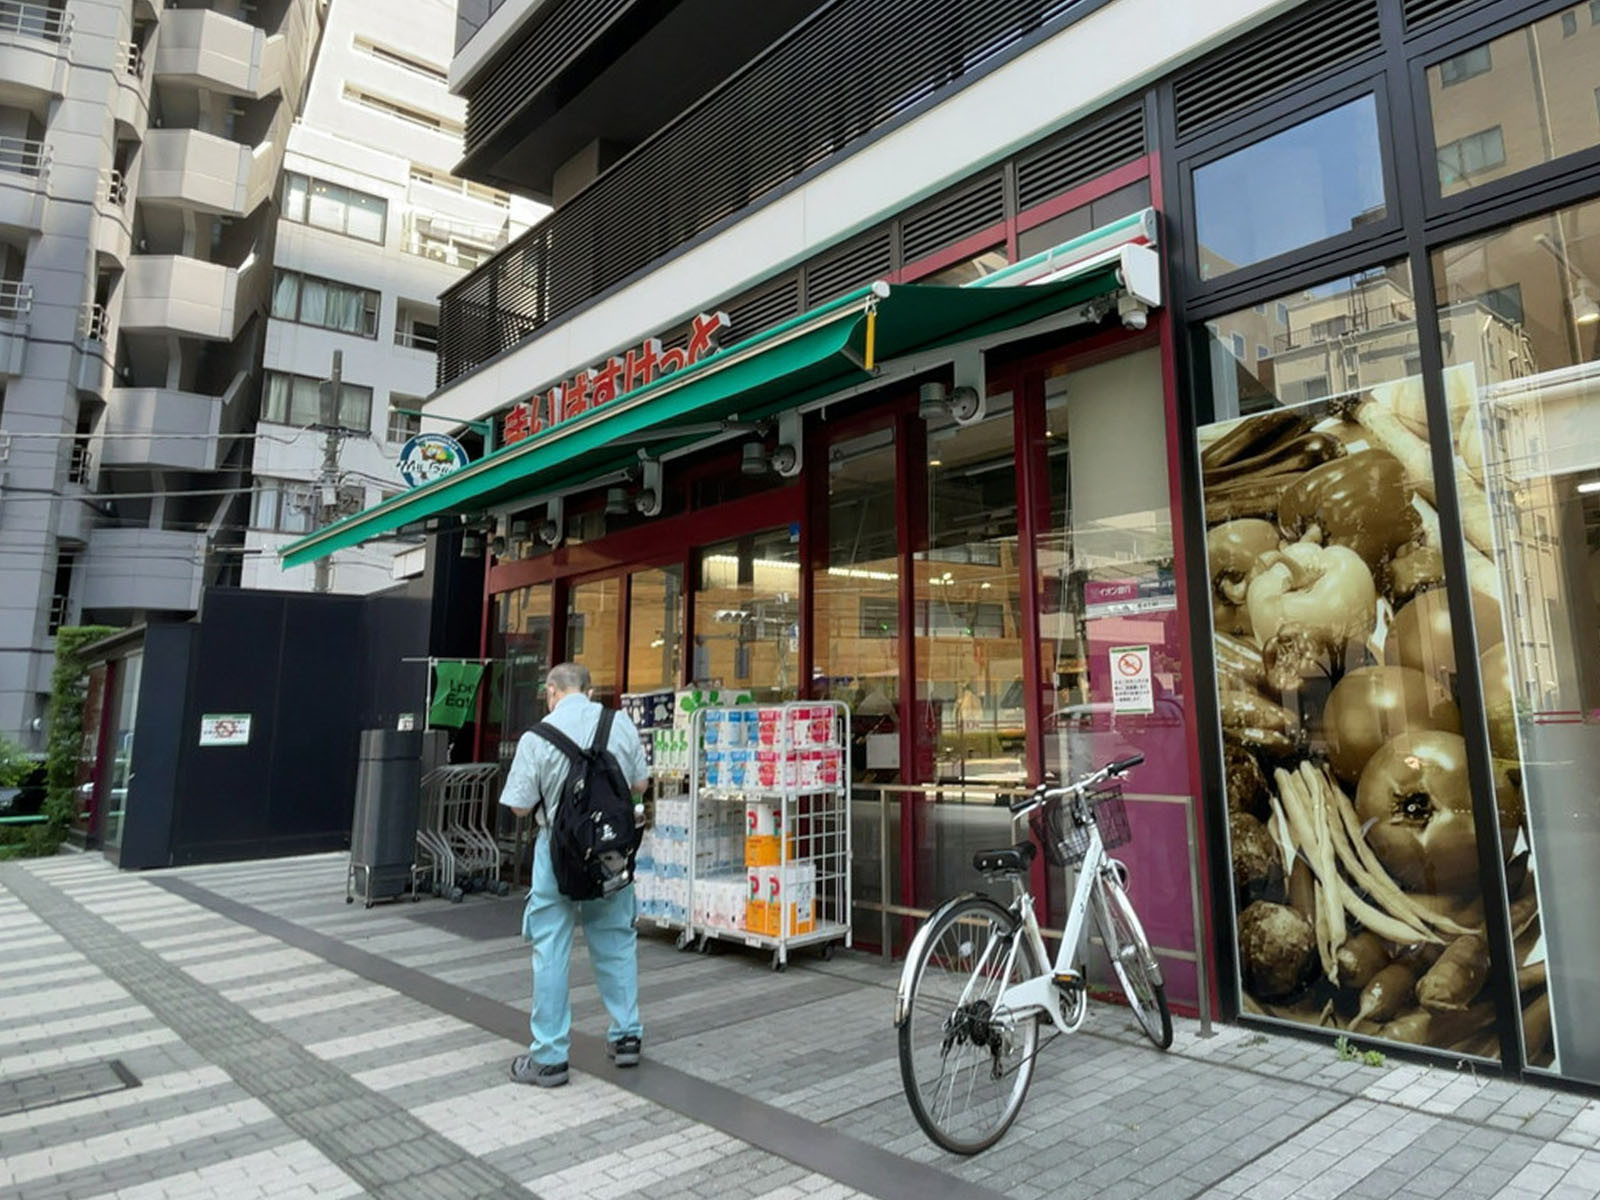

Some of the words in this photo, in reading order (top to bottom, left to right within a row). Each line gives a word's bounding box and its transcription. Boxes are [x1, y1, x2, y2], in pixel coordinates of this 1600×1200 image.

[504, 313, 724, 446] まいばすけっと
